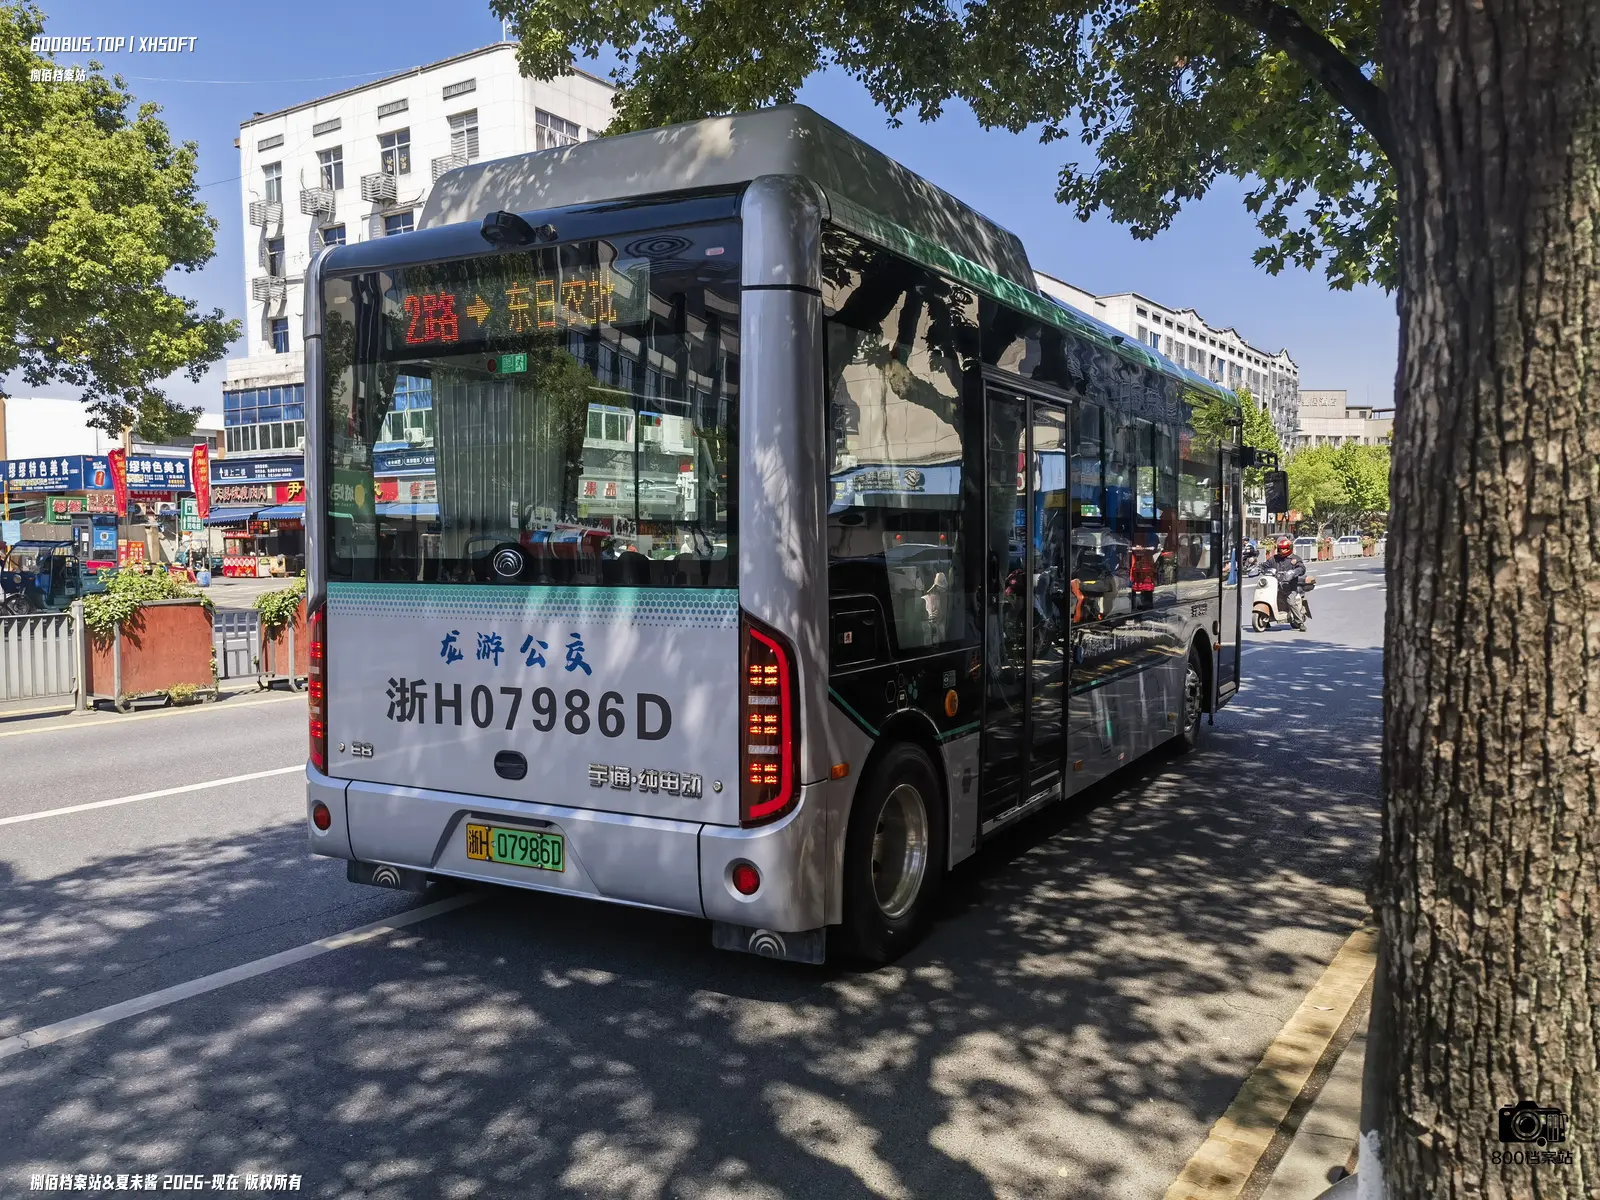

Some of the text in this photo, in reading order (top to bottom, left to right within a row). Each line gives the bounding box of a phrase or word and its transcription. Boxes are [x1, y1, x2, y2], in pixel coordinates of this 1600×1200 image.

[404, 291, 460, 344] 2路
[8, 458, 69, 478] 缪缪特色美食
[126, 460, 185, 474] 缪特色美食
[439, 629, 593, 676] 龙游公交
[385, 677, 673, 741] 浙H07986D
